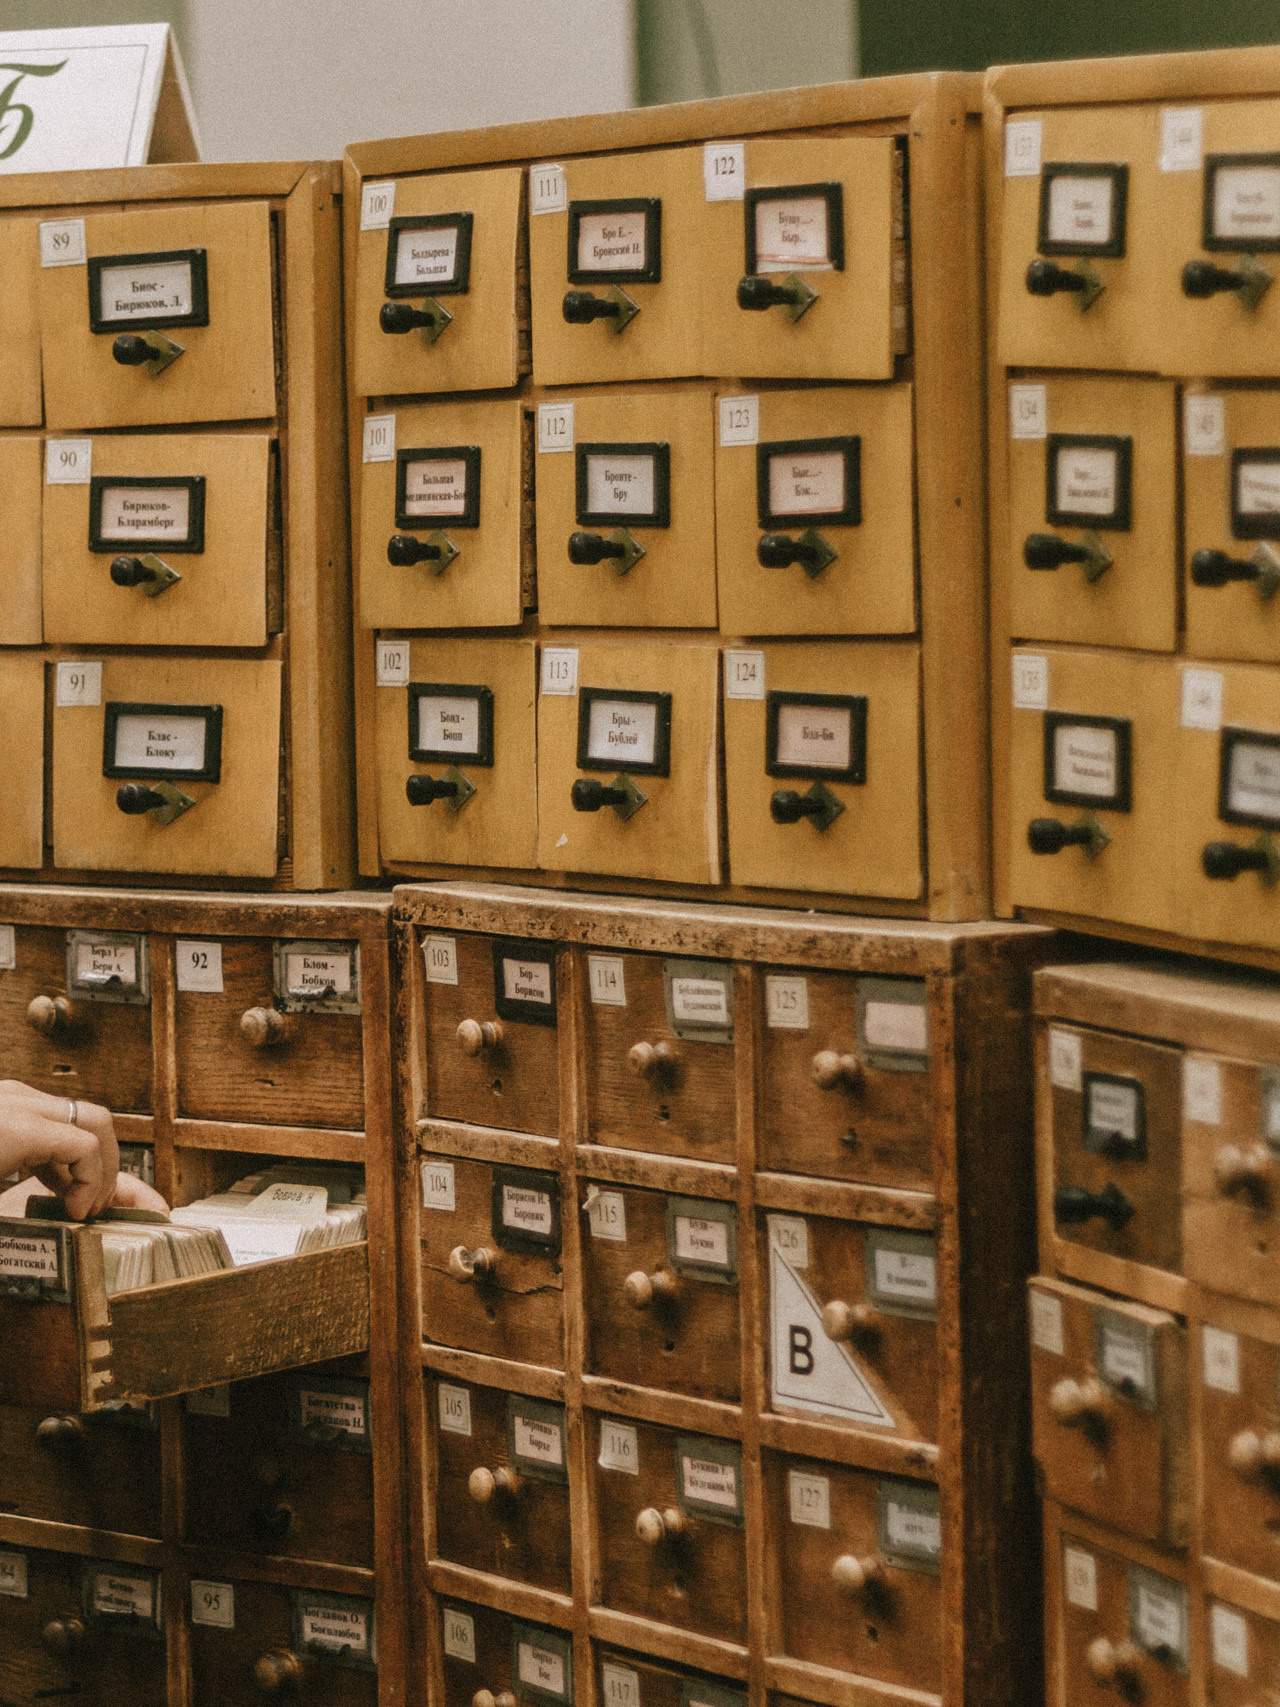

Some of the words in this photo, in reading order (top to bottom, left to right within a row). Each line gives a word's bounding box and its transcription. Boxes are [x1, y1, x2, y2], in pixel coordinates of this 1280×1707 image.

[714, 156, 735, 175] 122
[539, 177, 558, 198] 111
[369, 194, 387, 213] 100
[52, 232, 71, 250] 89
[545, 416, 566, 437] 112
[728, 408, 750, 429] 123
[370, 427, 387, 446] 101
[59, 451, 77, 468] 90
[117, 515, 174, 530] Бларамберг
[383, 652, 402, 671] 102
[549, 661, 568, 680] 113
[69, 674, 86, 690] 91
[735, 663, 757, 682] 124
[147, 730, 171, 742] Блас
[145, 746, 176, 760] Блоку
[191, 952, 208, 969] 92
[303, 957, 328, 971] Блом
[431, 948, 449, 967] 103
[597, 969, 617, 989] 114
[430, 1174, 448, 1193] 104
[597, 1203, 617, 1224] 115
[39, 1241, 50, 1254] А.
[776, 1228, 799, 1249] 126
[789, 1324, 815, 1376] В
[445, 1398, 463, 1418] 105
[610, 1434, 630, 1456] 116
[203, 1592, 220, 1611] 95
[451, 1622, 468, 1644] 106
[611, 1679, 629, 1700] 117
